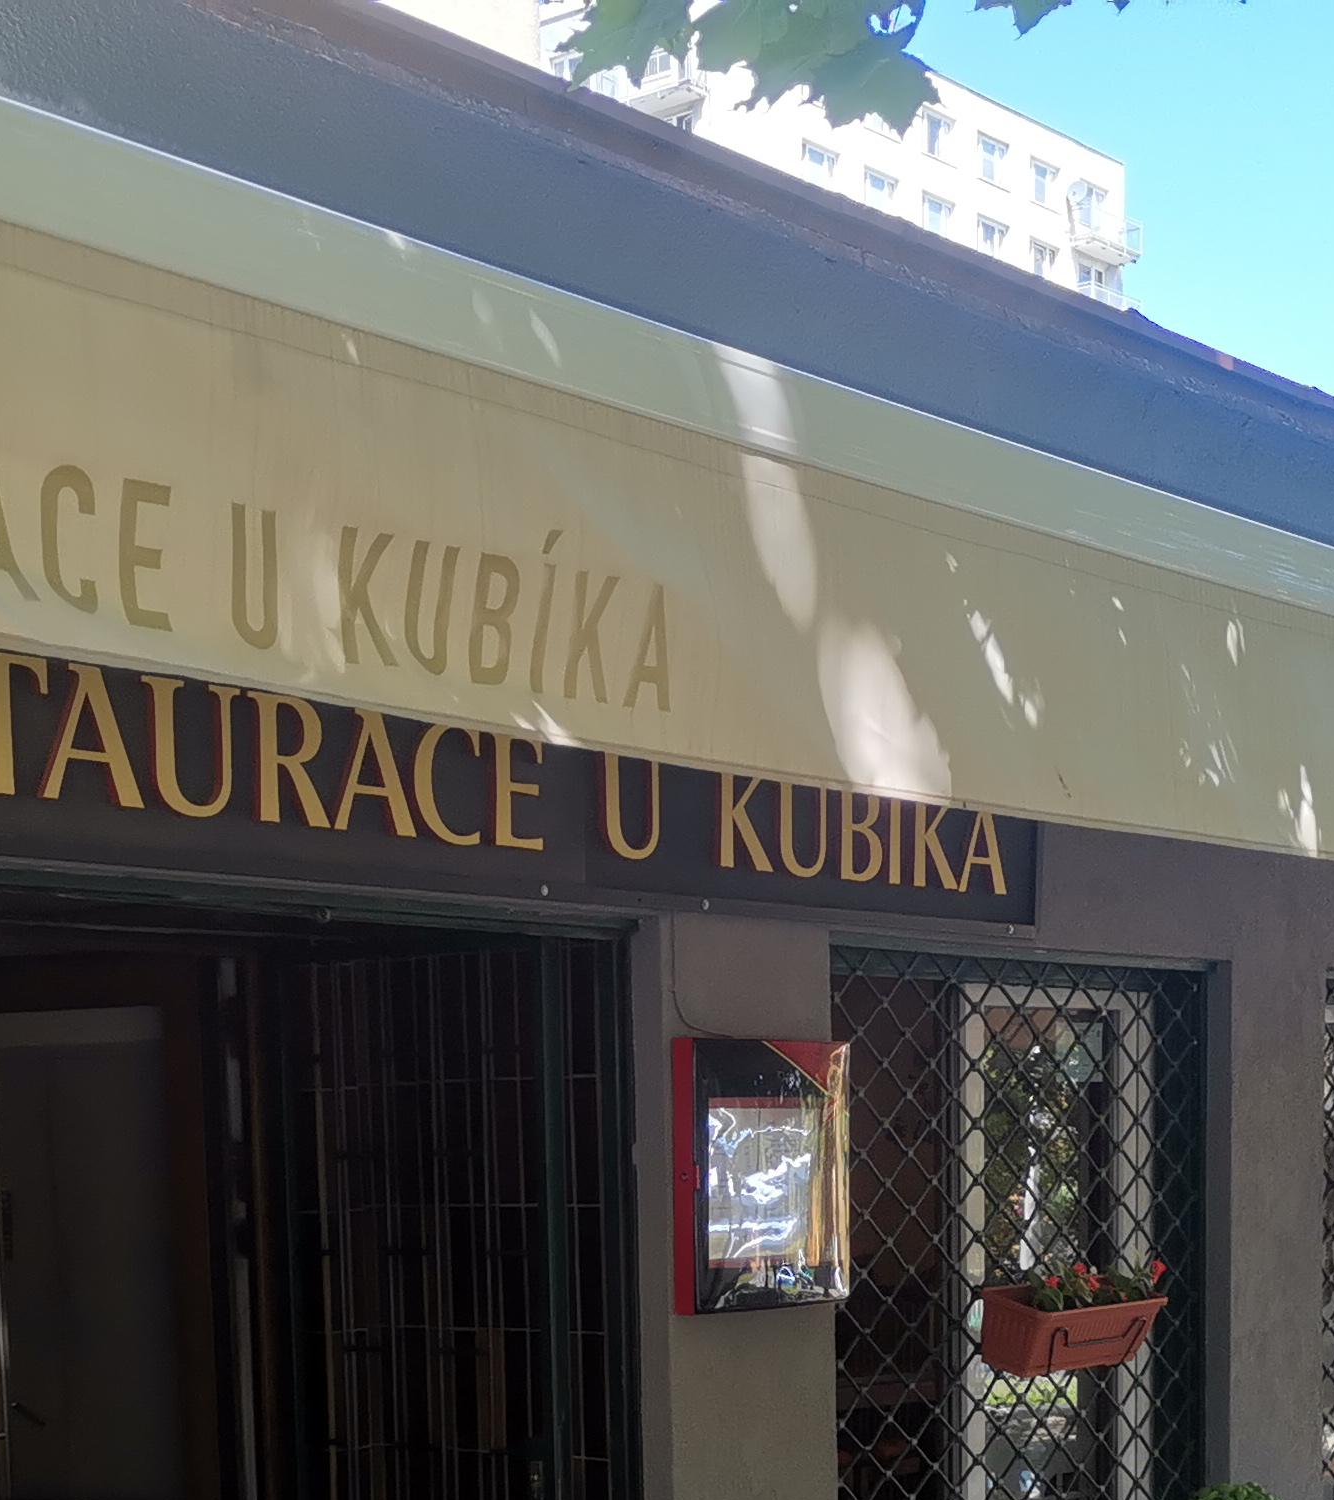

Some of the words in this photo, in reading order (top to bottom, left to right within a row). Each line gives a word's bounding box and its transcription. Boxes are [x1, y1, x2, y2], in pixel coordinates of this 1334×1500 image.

[230, 502, 278, 650] U
[336, 525, 672, 713] KUBÍKA
[601, 750, 661, 860] U
